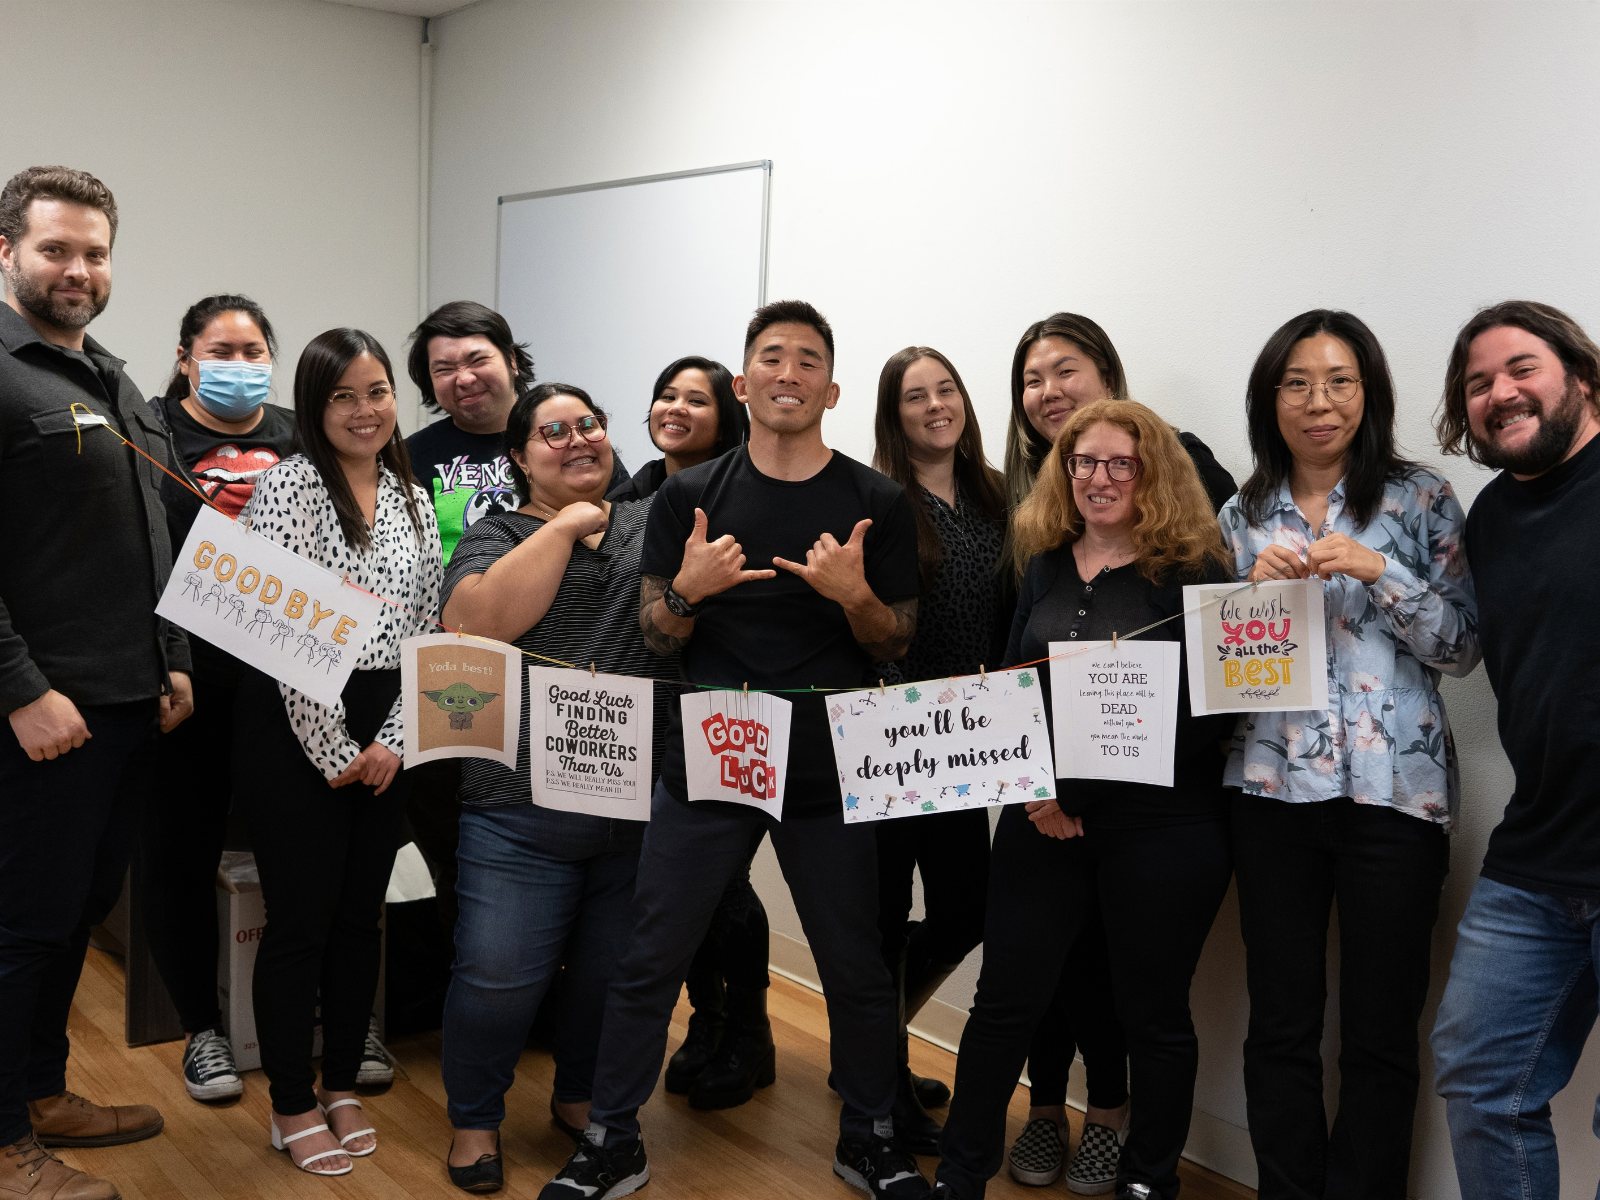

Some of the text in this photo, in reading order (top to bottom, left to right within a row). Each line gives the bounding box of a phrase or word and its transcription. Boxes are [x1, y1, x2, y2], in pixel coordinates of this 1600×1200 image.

[193, 540, 358, 646] GOODBYE
[1221, 593, 1290, 621] We wish
[1222, 618, 1291, 646] YOU
[1257, 643, 1280, 655] the
[429, 661, 493, 676] Yoda best!
[1120, 660, 1143, 669] believe
[1088, 673, 1148, 685] YOU ARE
[549, 685, 634, 710] Good Luck
[1104, 688, 1115, 696] this
[1116, 689, 1134, 699] place
[1135, 690, 1146, 698] will
[1148, 690, 1155, 698] be
[556, 702, 628, 725] FINDING
[1101, 703, 1138, 714] DEAD
[565, 719, 619, 742] Better
[884, 706, 991, 748] you'll be
[1103, 719, 1135, 729] without you
[707, 721, 768, 751] GOOD
[1120, 732, 1130, 740] the
[1132, 733, 1148, 741] world
[546, 736, 637, 761] COWORKERS
[1101, 744, 1140, 758] TO US
[559, 755, 624, 778] Than Us
[856, 734, 1031, 787] deeply missed
[557, 770, 567, 779] WE
[568, 772, 582, 781] WILL
[584, 775, 606, 784] REALLY
[607, 778, 621, 786] MISS
[560, 779, 571, 788] WE
[572, 781, 594, 791] REALLY
[595, 785, 613, 793] MEAN
[724, 760, 775, 793] LUCK
